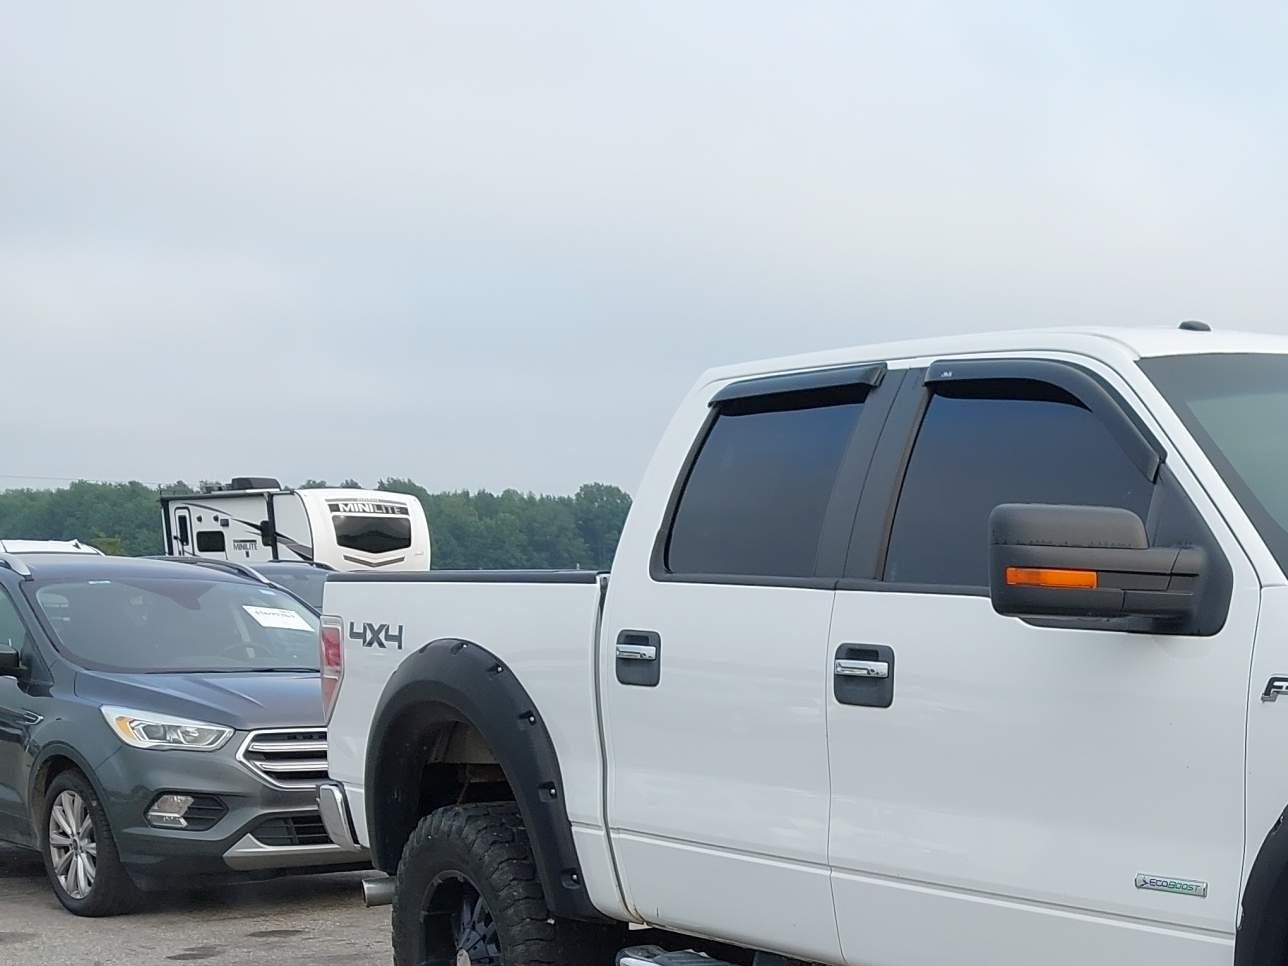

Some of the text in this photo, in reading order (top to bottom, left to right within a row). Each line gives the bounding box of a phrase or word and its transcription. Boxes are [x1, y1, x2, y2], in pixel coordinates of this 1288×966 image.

[338, 503, 401, 514] MINILITE
[349, 621, 404, 650] 4X4
[1149, 878, 1201, 892] ECOBOOST
